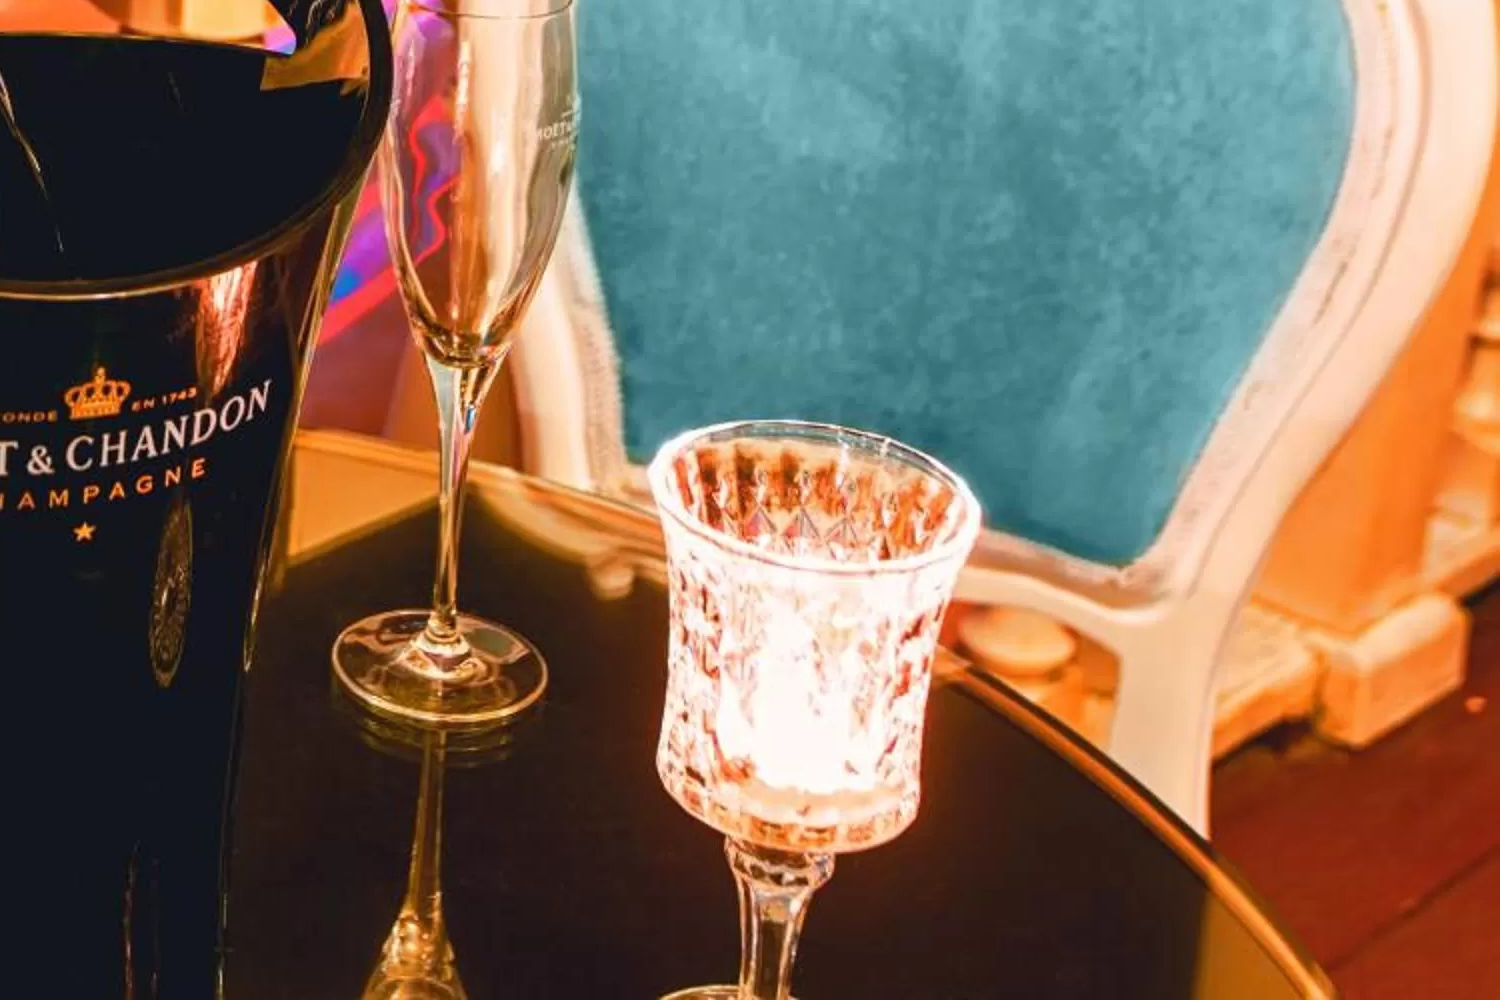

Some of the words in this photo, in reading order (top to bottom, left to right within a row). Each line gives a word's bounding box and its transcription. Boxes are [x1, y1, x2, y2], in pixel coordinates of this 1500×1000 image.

[26, 445, 56, 475] &
[65, 378, 273, 471] CHANDON
[131, 397, 155, 412] EN
